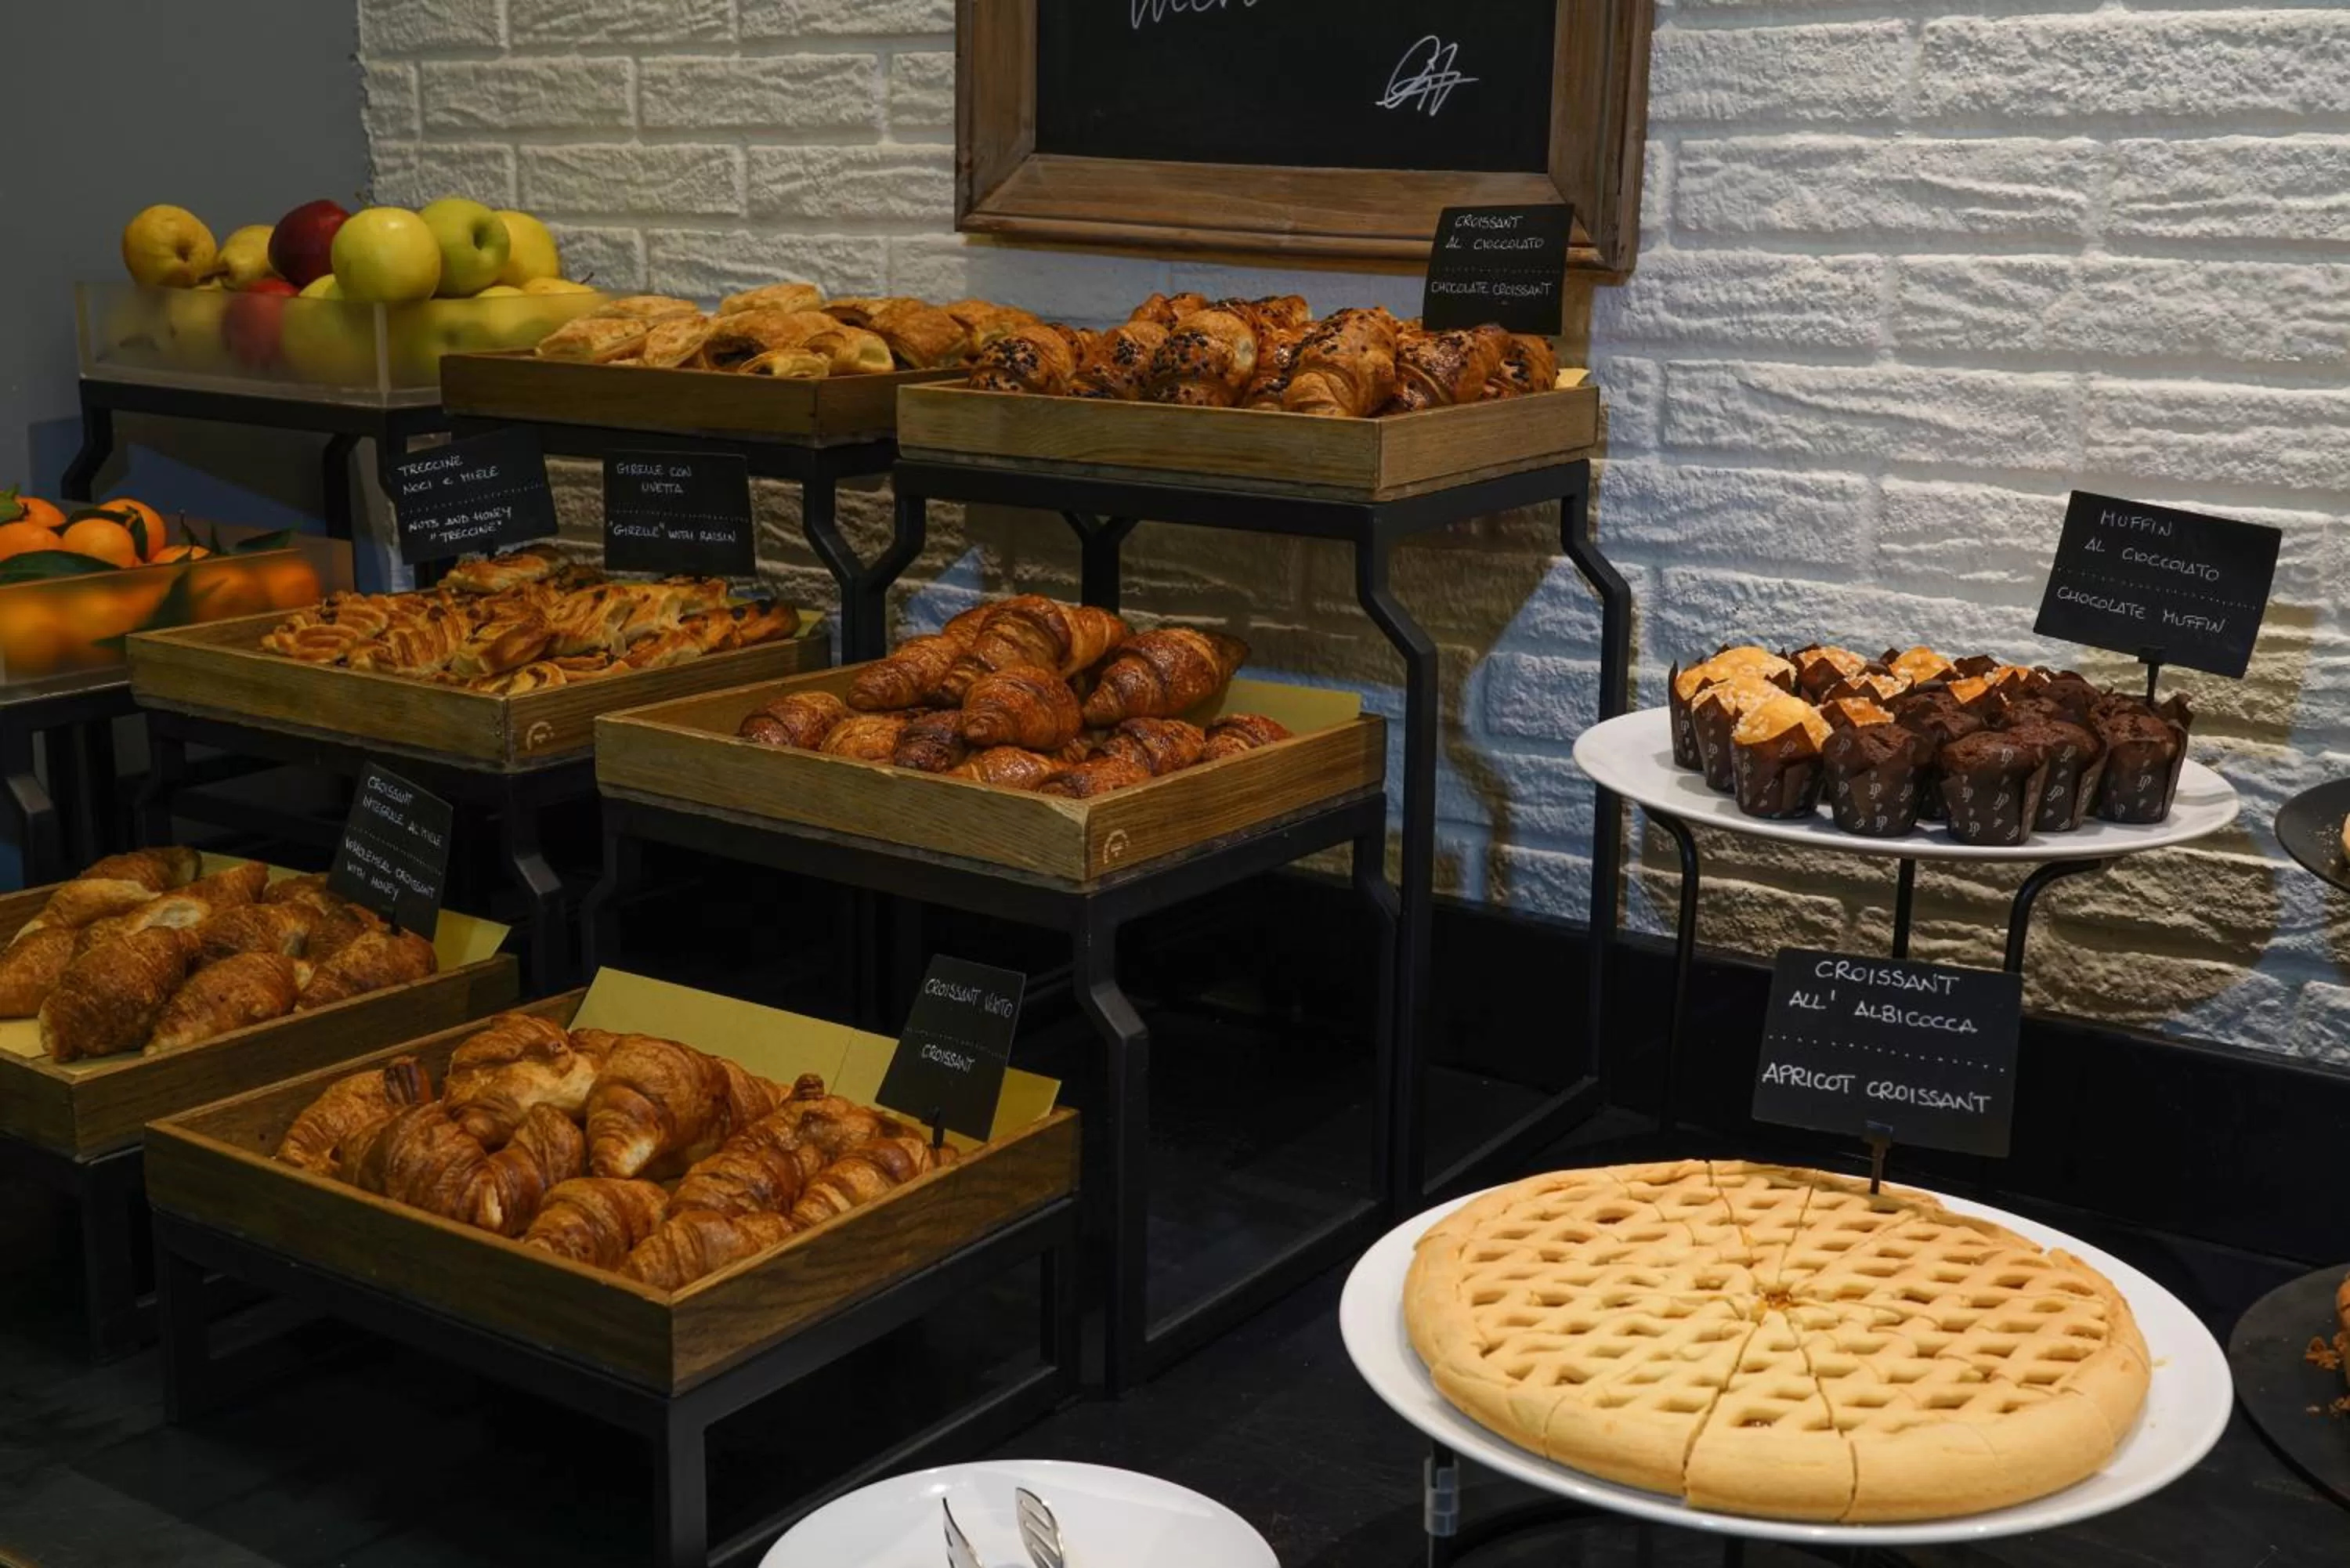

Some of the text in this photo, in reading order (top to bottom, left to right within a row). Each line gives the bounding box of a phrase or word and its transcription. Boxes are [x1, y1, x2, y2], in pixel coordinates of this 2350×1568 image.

[1455, 214, 1523, 229] CROISSANT
[1445, 235, 1545, 251] AL CIOCCOLATO
[1431, 282, 1553, 297] CHOCOLATE CROISSANT
[397, 455, 463, 476] TRECCINE
[670, 464, 692, 477] CON
[403, 481, 432, 495] NOCI
[461, 466, 499, 482] MIELE
[642, 481, 684, 494] UVETTA
[408, 507, 512, 533] NUTS AND HONEY
[2100, 510, 2172, 537] MUFFIN
[667, 529, 694, 540] WITH
[700, 529, 736, 543] RAISIN
[2084, 537, 2219, 581] AL CIOCCOLATO
[2057, 587, 2225, 634] CHOCOLATE MUFFIN
[1815, 960, 1960, 995] CROISSANT
[924, 978, 981, 1006] CROISSANT
[1788, 989, 1978, 1033] ALL' ALBICOCCA
[921, 1044, 975, 1073] CROISSANT
[1762, 1062, 1991, 1113] APRICOT CROISSANT
